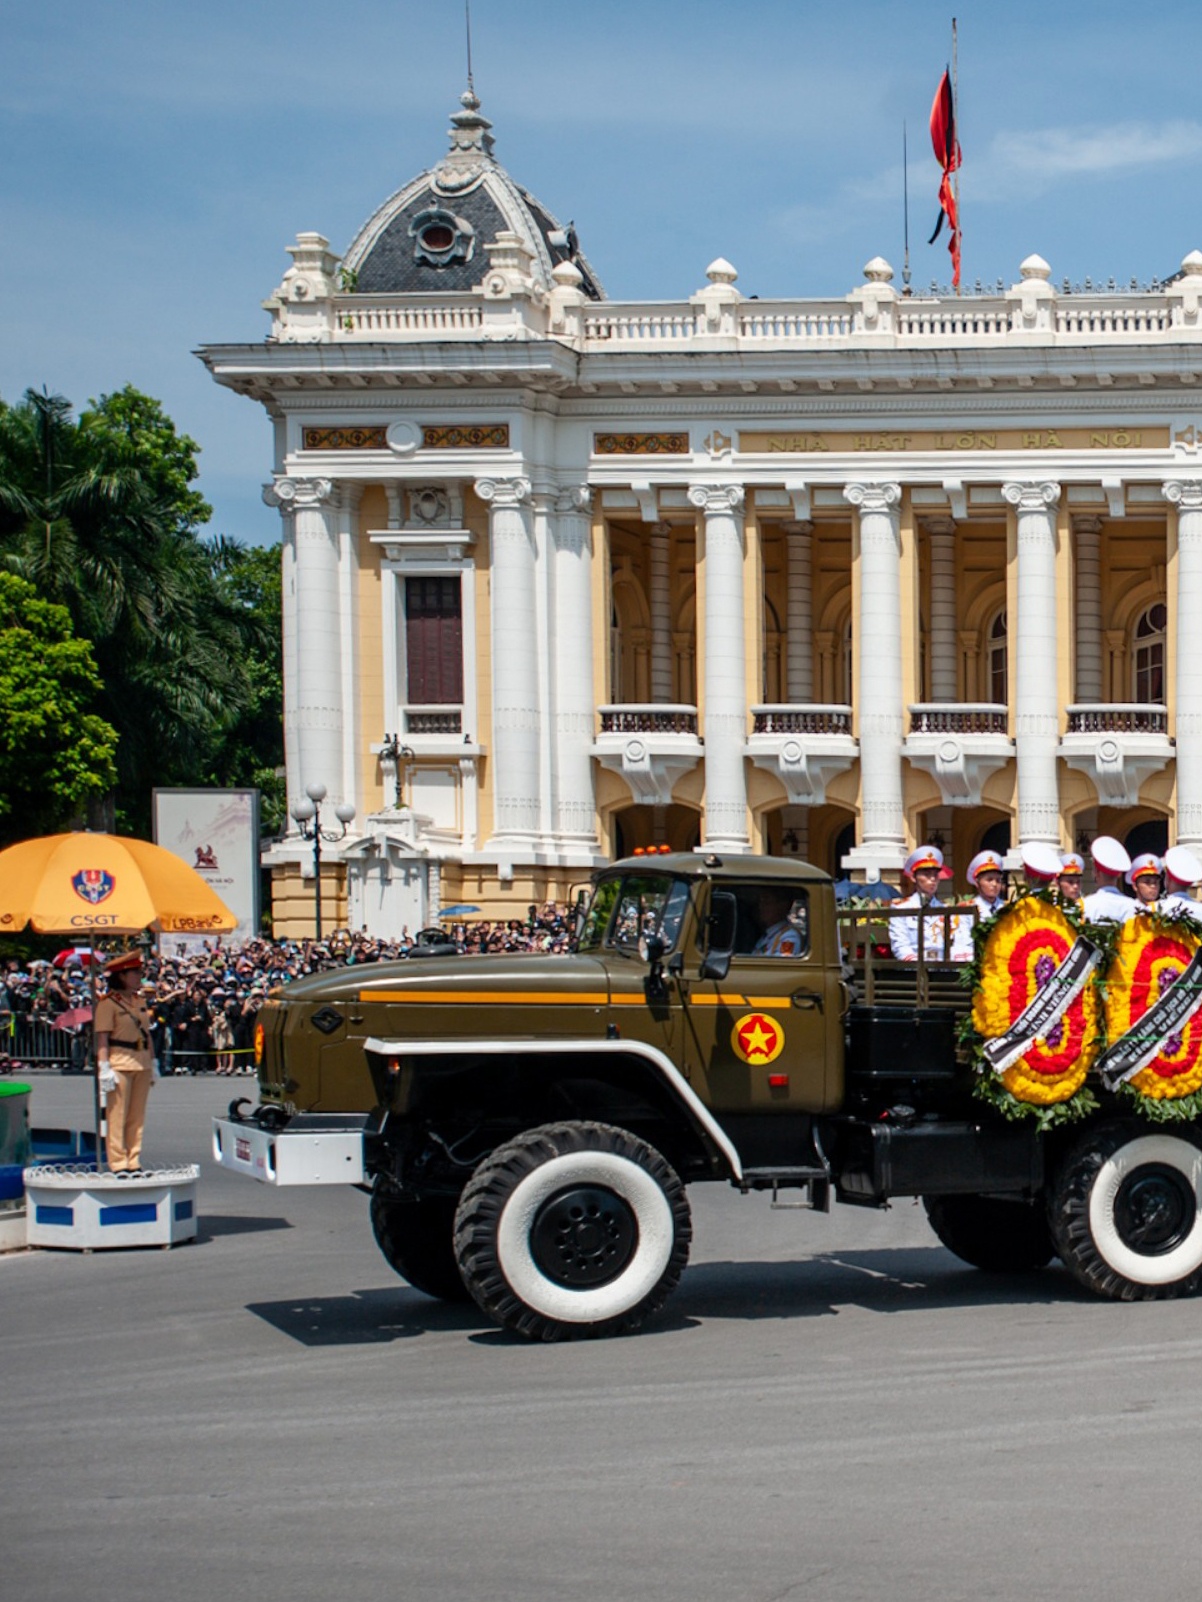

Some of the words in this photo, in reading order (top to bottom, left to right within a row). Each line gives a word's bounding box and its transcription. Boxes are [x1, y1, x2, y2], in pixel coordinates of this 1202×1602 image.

[767, 431, 830, 452] NHÀ
[853, 430, 912, 451] HÁT
[934, 430, 997, 450] LỚN
[1021, 429, 1064, 449] HÀ
[1090, 428, 1142, 448] NỘI
[71, 914, 120, 926] CSGT
